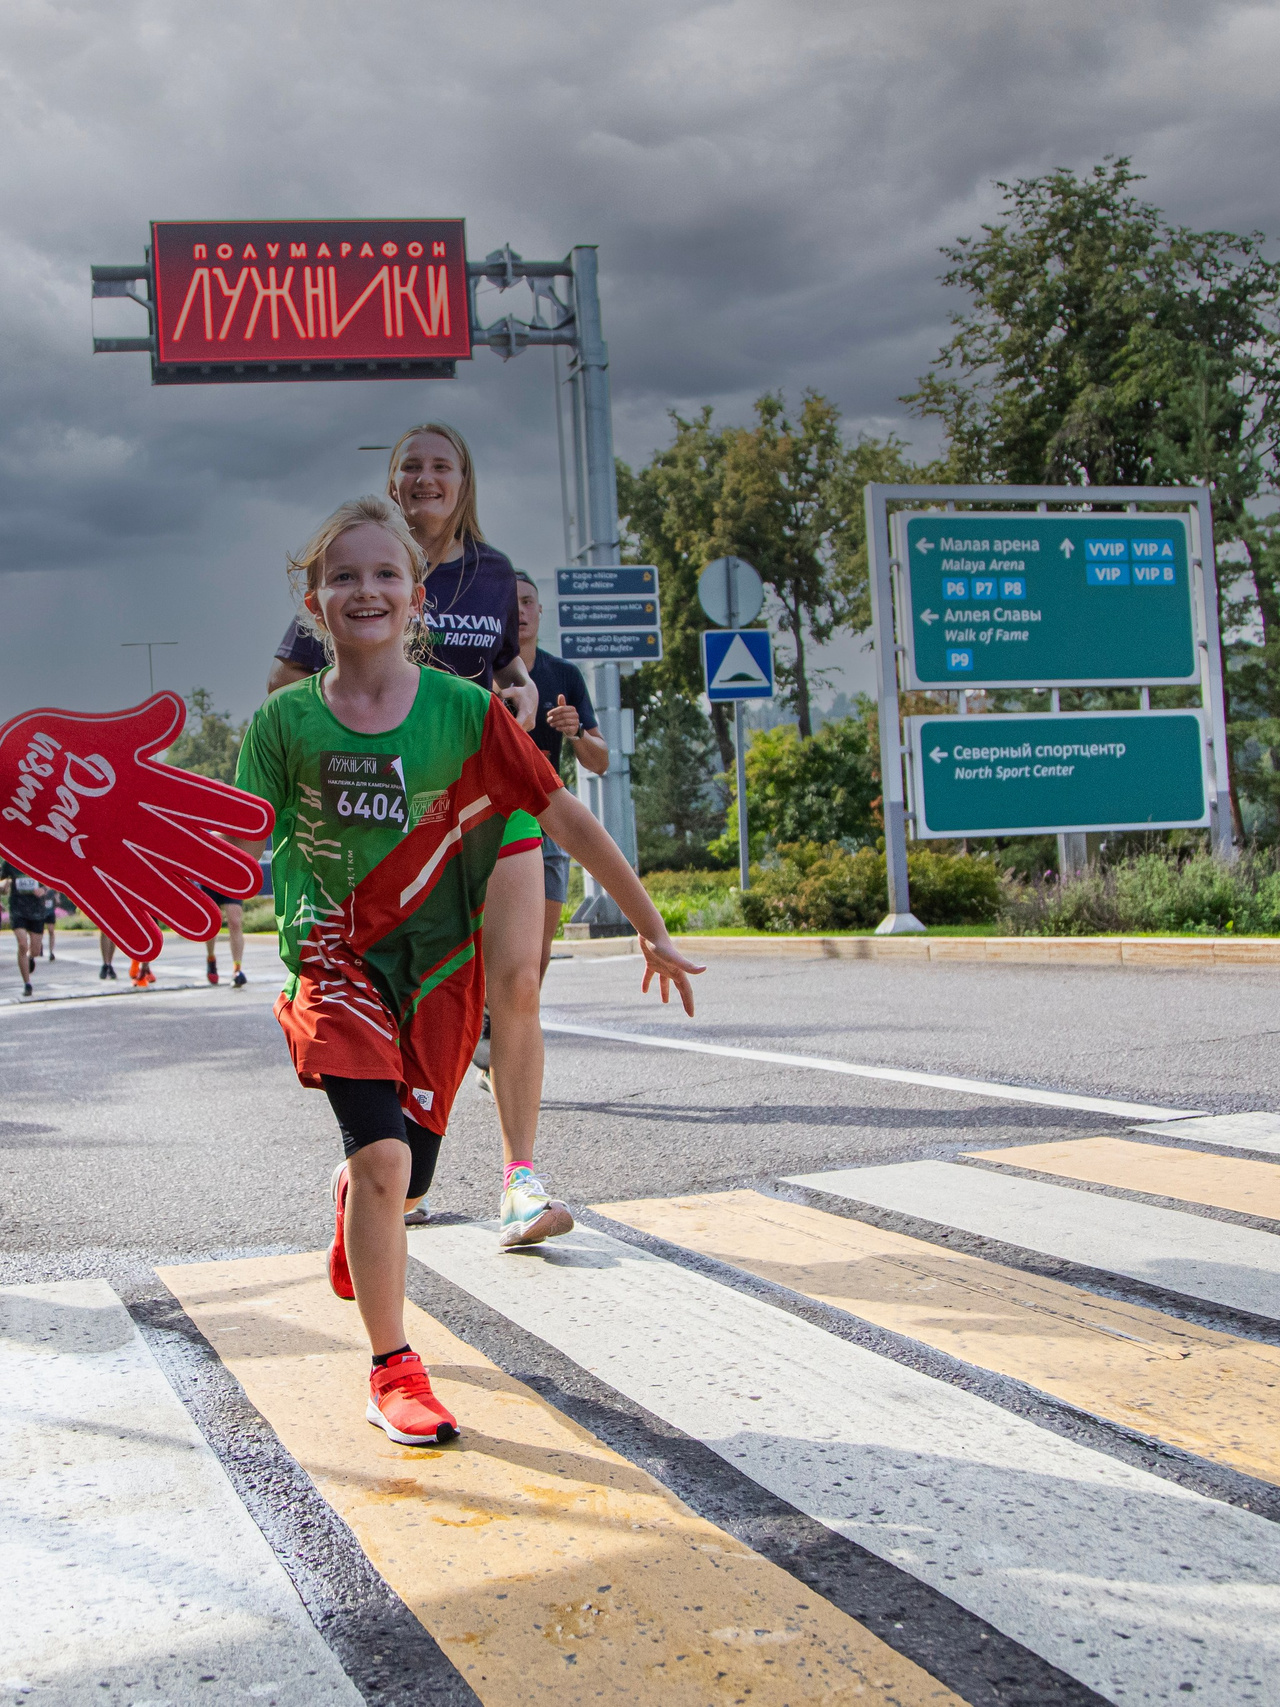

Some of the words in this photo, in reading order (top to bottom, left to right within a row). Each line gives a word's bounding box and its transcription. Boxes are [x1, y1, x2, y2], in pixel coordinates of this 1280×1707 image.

[193, 241, 447, 260] ПОЛУМАРАФОН
[172, 265, 451, 341] ЛУЖНИКИ
[940, 537, 990, 552] Малая
[993, 539, 1040, 555] арена
[1089, 543, 1125, 557] VVIP
[1133, 543, 1159, 557] VIP
[1161, 544, 1173, 557] A
[942, 558, 986, 573] Malaya
[989, 558, 1025, 571] Arena
[1095, 568, 1121, 581] VIP
[1135, 567, 1160, 581] VIP
[1163, 568, 1174, 581] B
[946, 582, 965, 596] P6
[975, 582, 993, 596] P7
[1004, 582, 1022, 596] P8
[944, 608, 990, 622] Аллея
[993, 608, 1042, 622] Славы
[945, 629, 976, 642] Walk
[979, 628, 994, 645] of
[995, 629, 1029, 641] Fame
[951, 653, 969, 667] P9
[953, 743, 1032, 763] Северный
[1035, 742, 1126, 760] спортцентр
[328, 757, 377, 774] ЛУЖНИКИ
[955, 766, 993, 779] North
[996, 765, 1030, 781] Sport
[1033, 763, 1074, 777] Center
[337, 790, 405, 824] 6404
